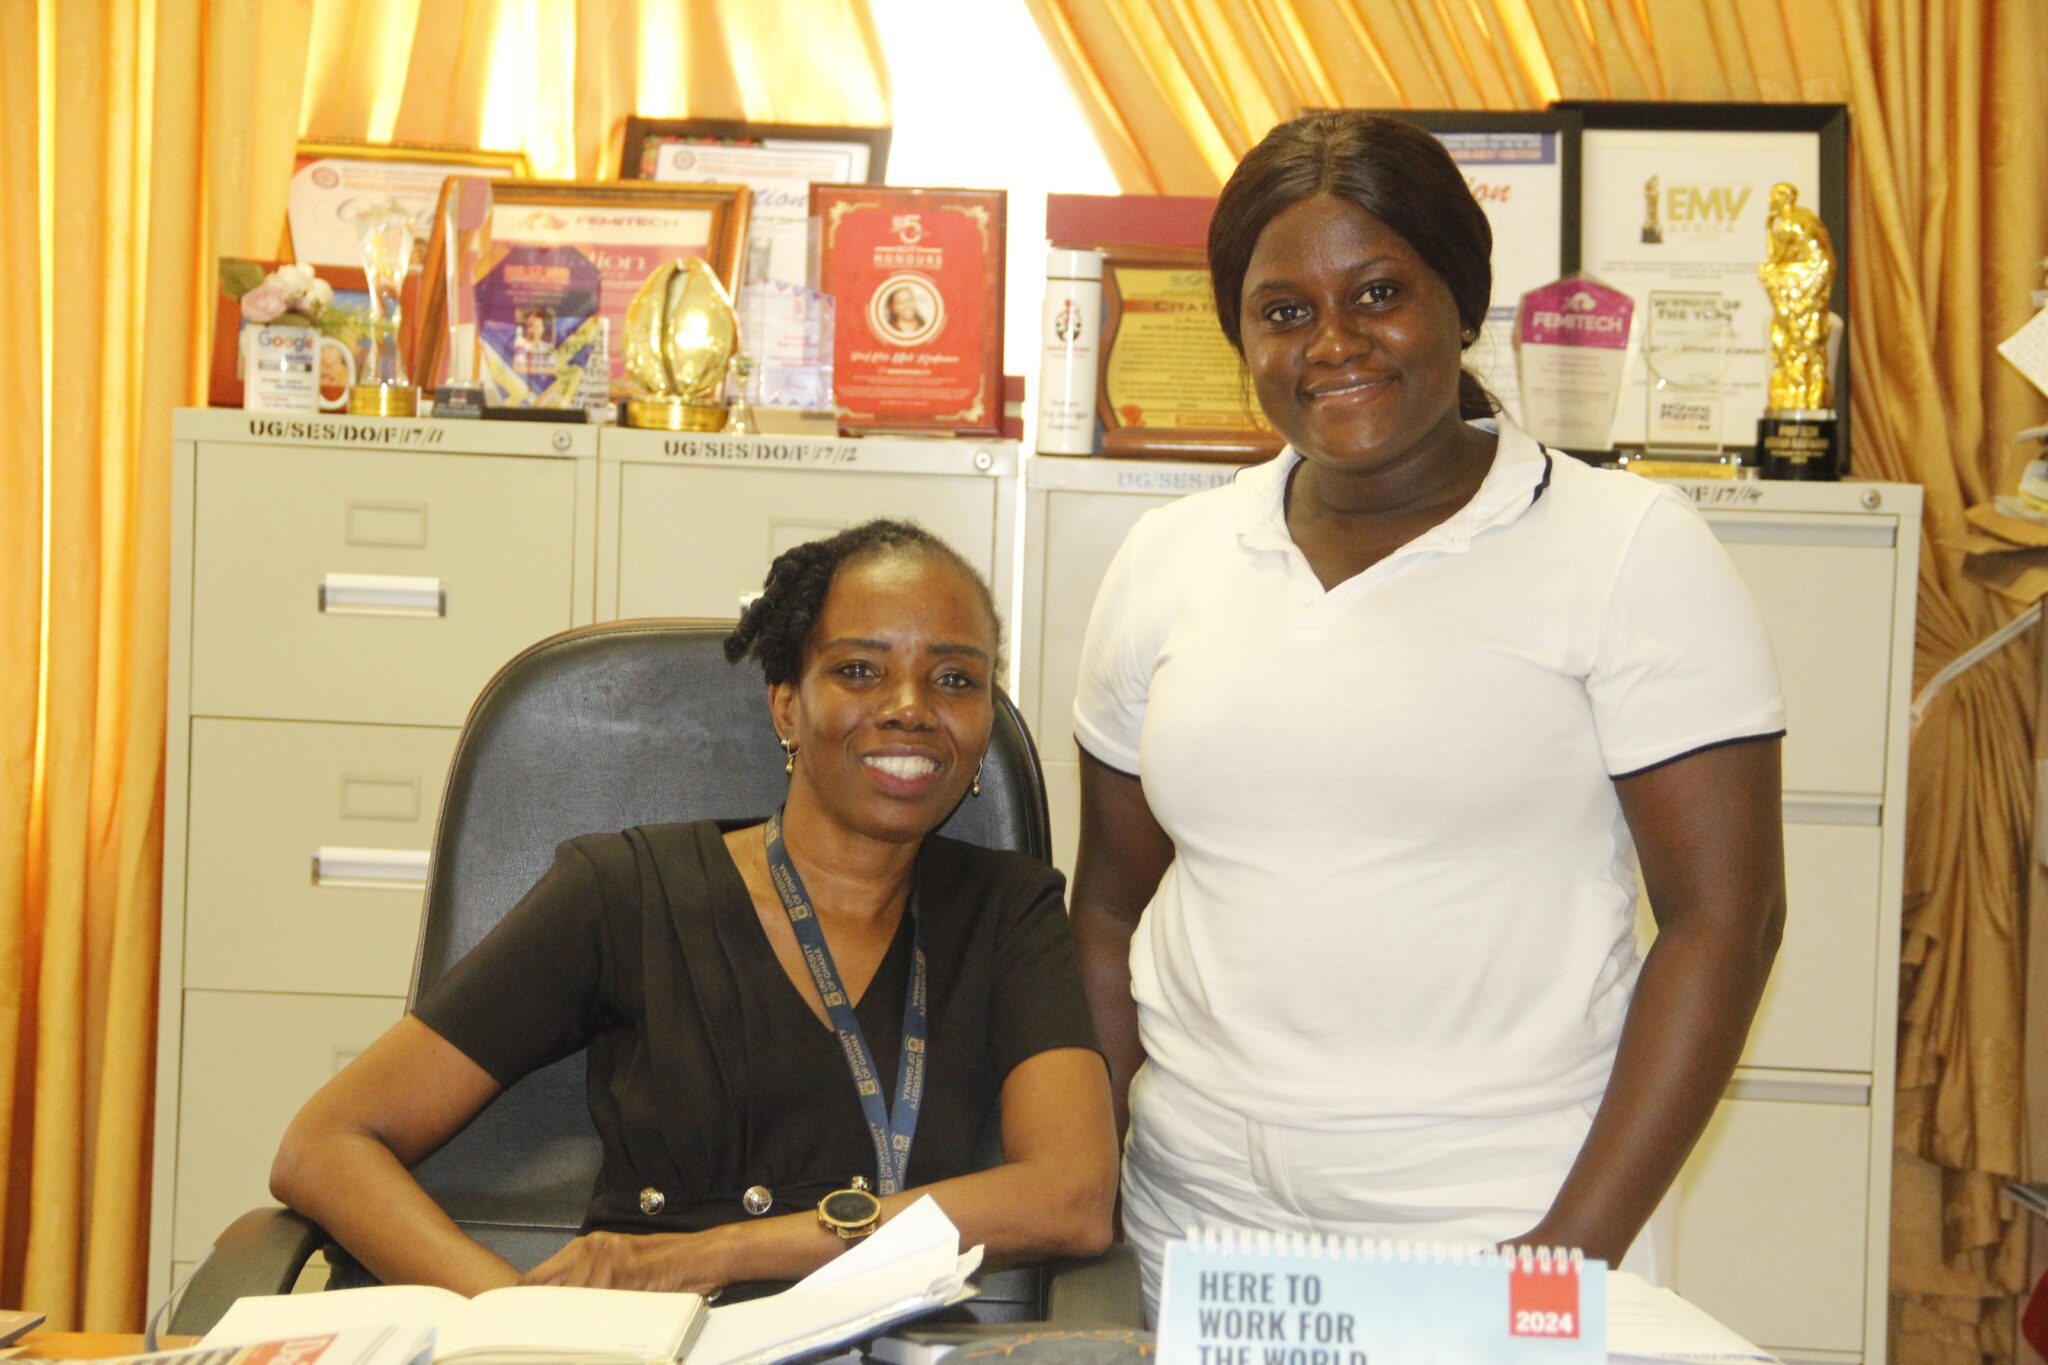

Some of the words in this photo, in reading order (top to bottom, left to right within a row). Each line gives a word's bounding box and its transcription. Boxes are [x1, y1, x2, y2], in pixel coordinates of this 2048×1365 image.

[1532, 312, 1623, 332] FEMITECH
[258, 329, 313, 352] Google
[902, 1064, 914, 1100] GHANA
[910, 1054, 924, 1110] UNIVERSITY
[1200, 1272, 1275, 1304] HERE
[1286, 1274, 1321, 1306] TO
[1199, 1308, 1286, 1341] WORK
[1299, 1311, 1355, 1344] FOR
[1516, 1310, 1573, 1333] 2024
[1198, 1345, 1251, 1365] THE
